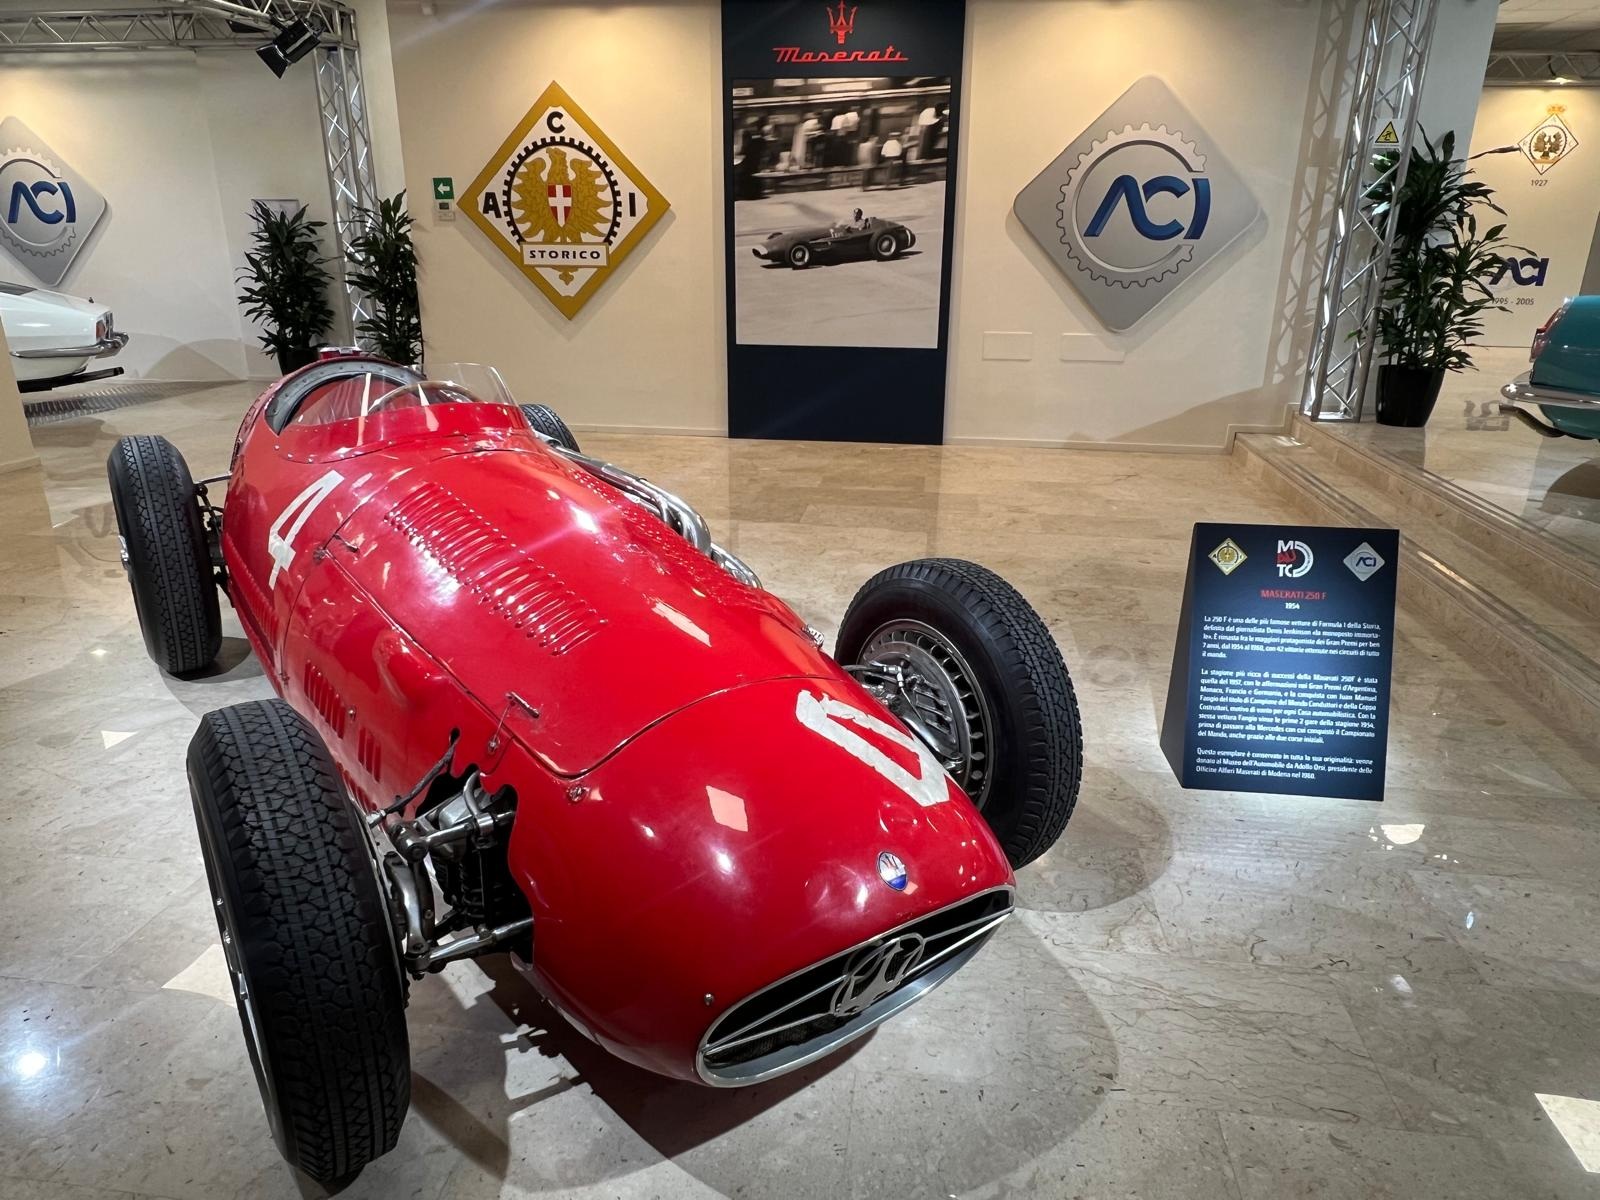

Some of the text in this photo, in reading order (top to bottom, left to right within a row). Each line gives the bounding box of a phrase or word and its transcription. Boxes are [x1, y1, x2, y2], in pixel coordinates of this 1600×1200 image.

[772, 45, 909, 63] Maserati
[547, 111, 566, 134] C
[8, 181, 76, 224] ACI
[482, 192, 637, 218] A I
[1083, 174, 1211, 241] ACI
[529, 250, 601, 260] STORICO
[1516, 297, 1535, 306] 2005
[268, 470, 345, 591] 4
[1261, 589, 1304, 599] MASERATI
[1304, 591, 1320, 600] 250
[1284, 602, 1300, 610] 1954
